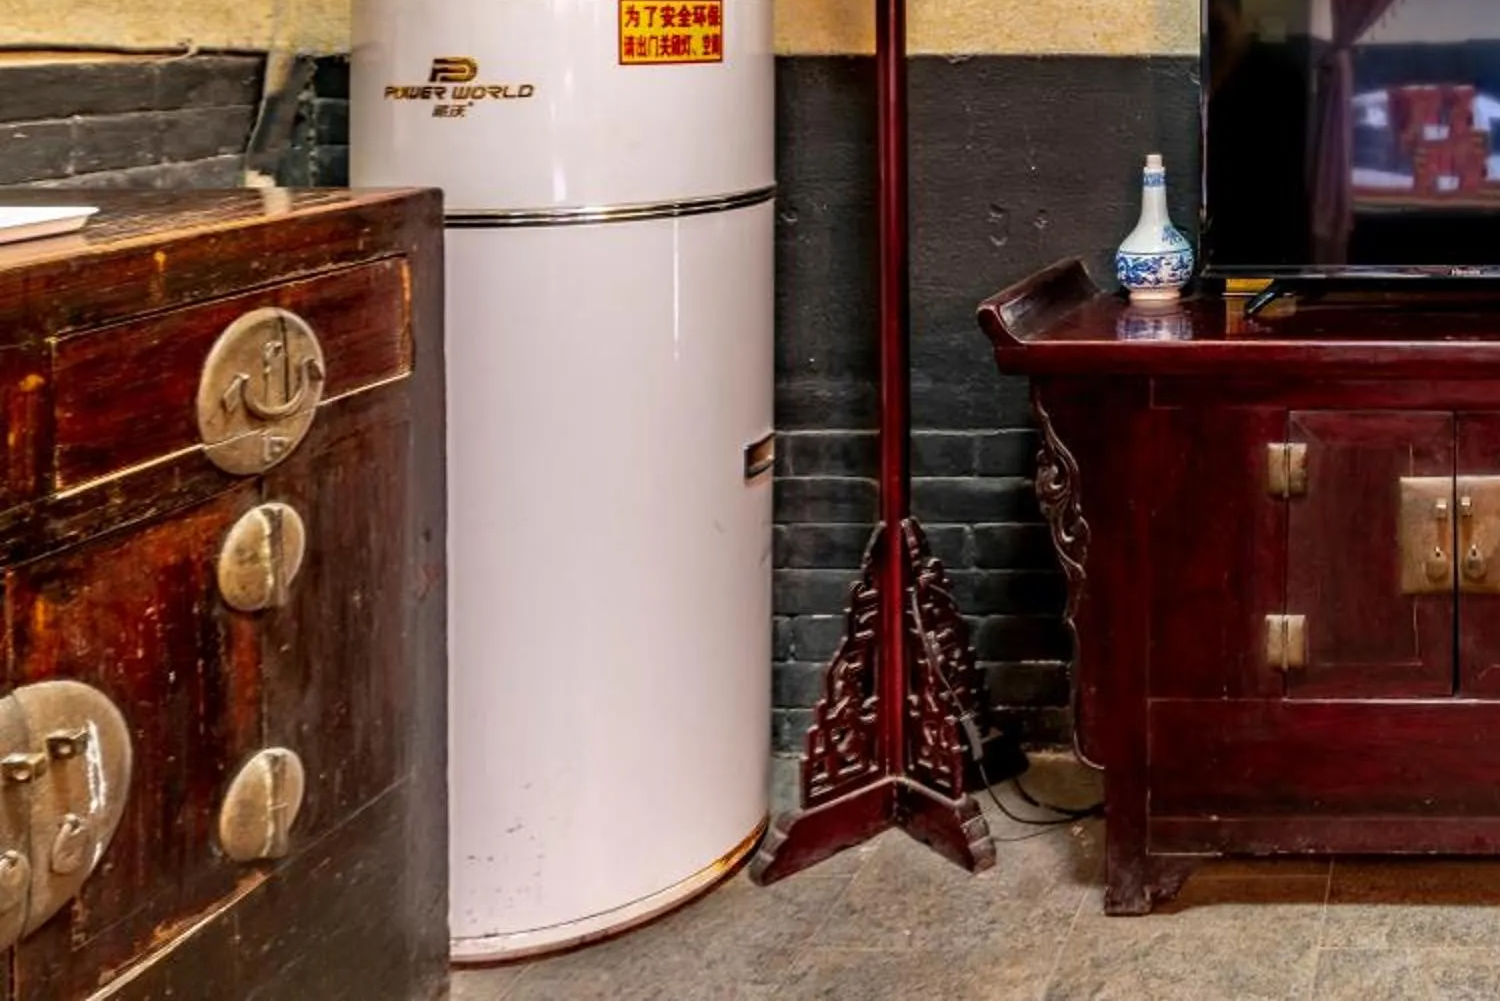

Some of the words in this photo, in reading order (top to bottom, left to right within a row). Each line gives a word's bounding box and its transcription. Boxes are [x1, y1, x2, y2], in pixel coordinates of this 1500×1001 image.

[624, 4, 720, 28] 为了安全环保
[383, 85, 447, 100] POWER
[451, 84, 535, 100] WORLD
